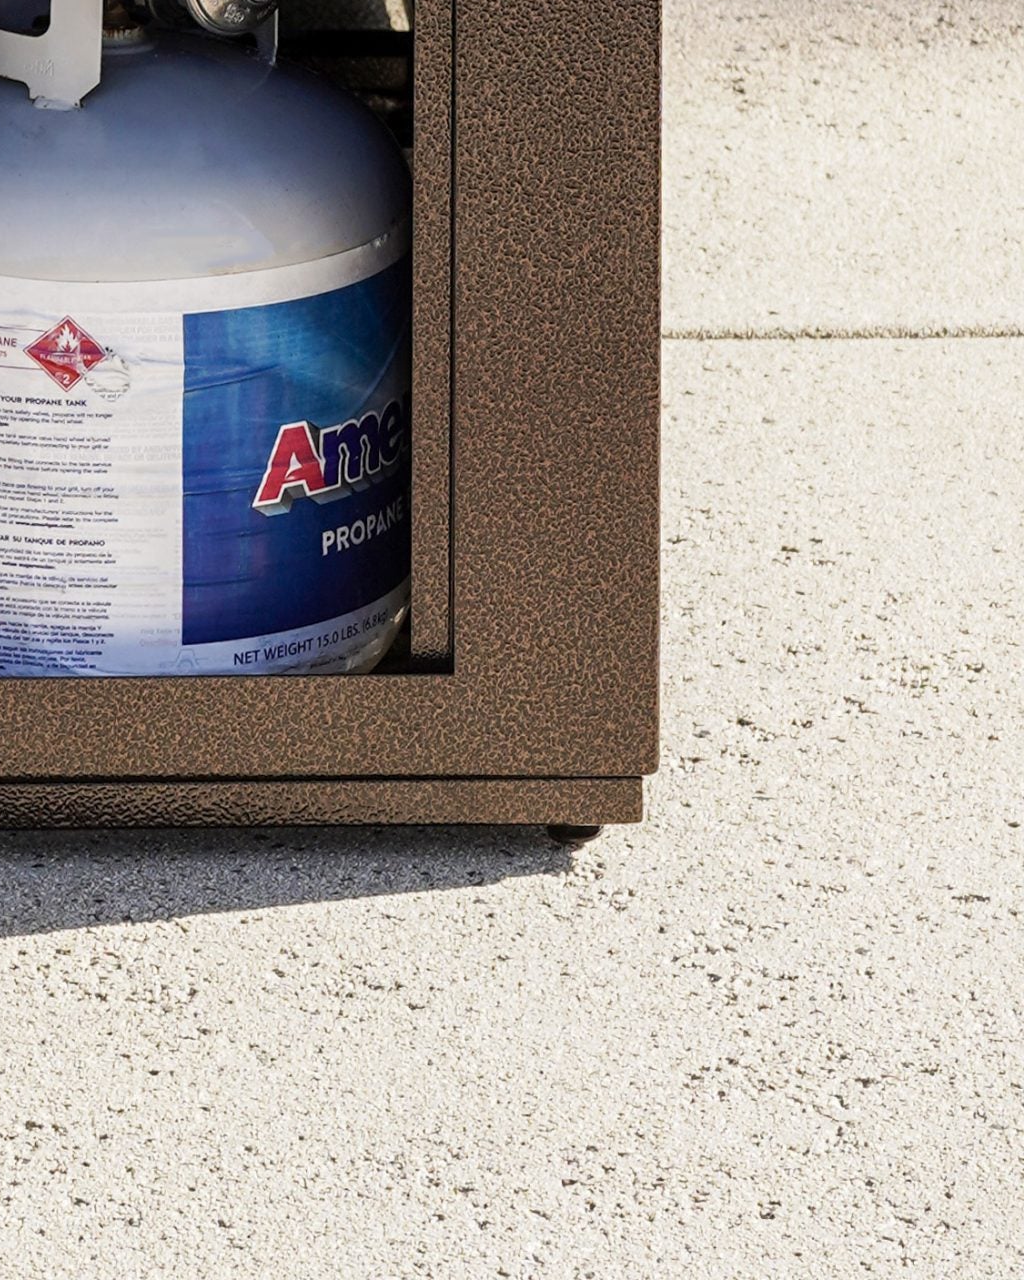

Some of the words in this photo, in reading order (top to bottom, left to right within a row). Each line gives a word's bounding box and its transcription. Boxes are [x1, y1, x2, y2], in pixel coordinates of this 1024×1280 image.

[0, 395, 22, 403] YOUR
[25, 397, 62, 405] PROPANE
[66, 399, 87, 407] TANK
[251, 399, 409, 513] Ame
[24, 537, 53, 545] TANQUE
[322, 496, 404, 556] PROPANE
[233, 649, 260, 665] NET
[263, 639, 313, 660] WEIGHT
[317, 632, 339, 648] 15.0
[341, 623, 360, 641] LBS.
